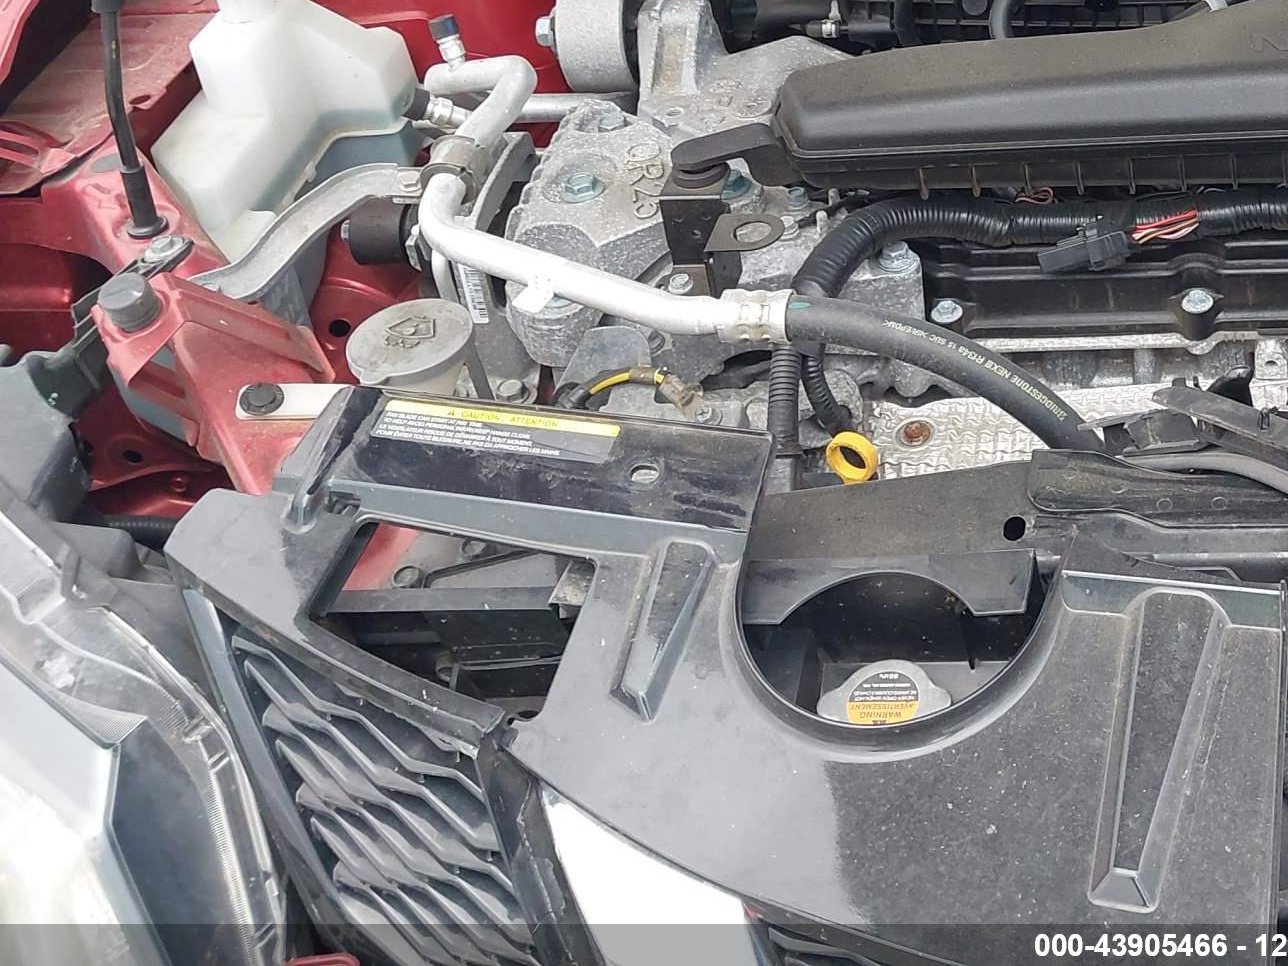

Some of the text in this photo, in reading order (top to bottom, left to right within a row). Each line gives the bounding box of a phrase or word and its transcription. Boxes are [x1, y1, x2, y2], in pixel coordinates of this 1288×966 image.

[928, 335, 947, 345] SUC
[958, 345, 985, 364] R134a
[1010, 375, 1068, 422] BRIDGESTONE
[462, 410, 499, 421] CAUTION
[510, 416, 558, 427] ATTENTION
[860, 711, 902, 719] WARNING
